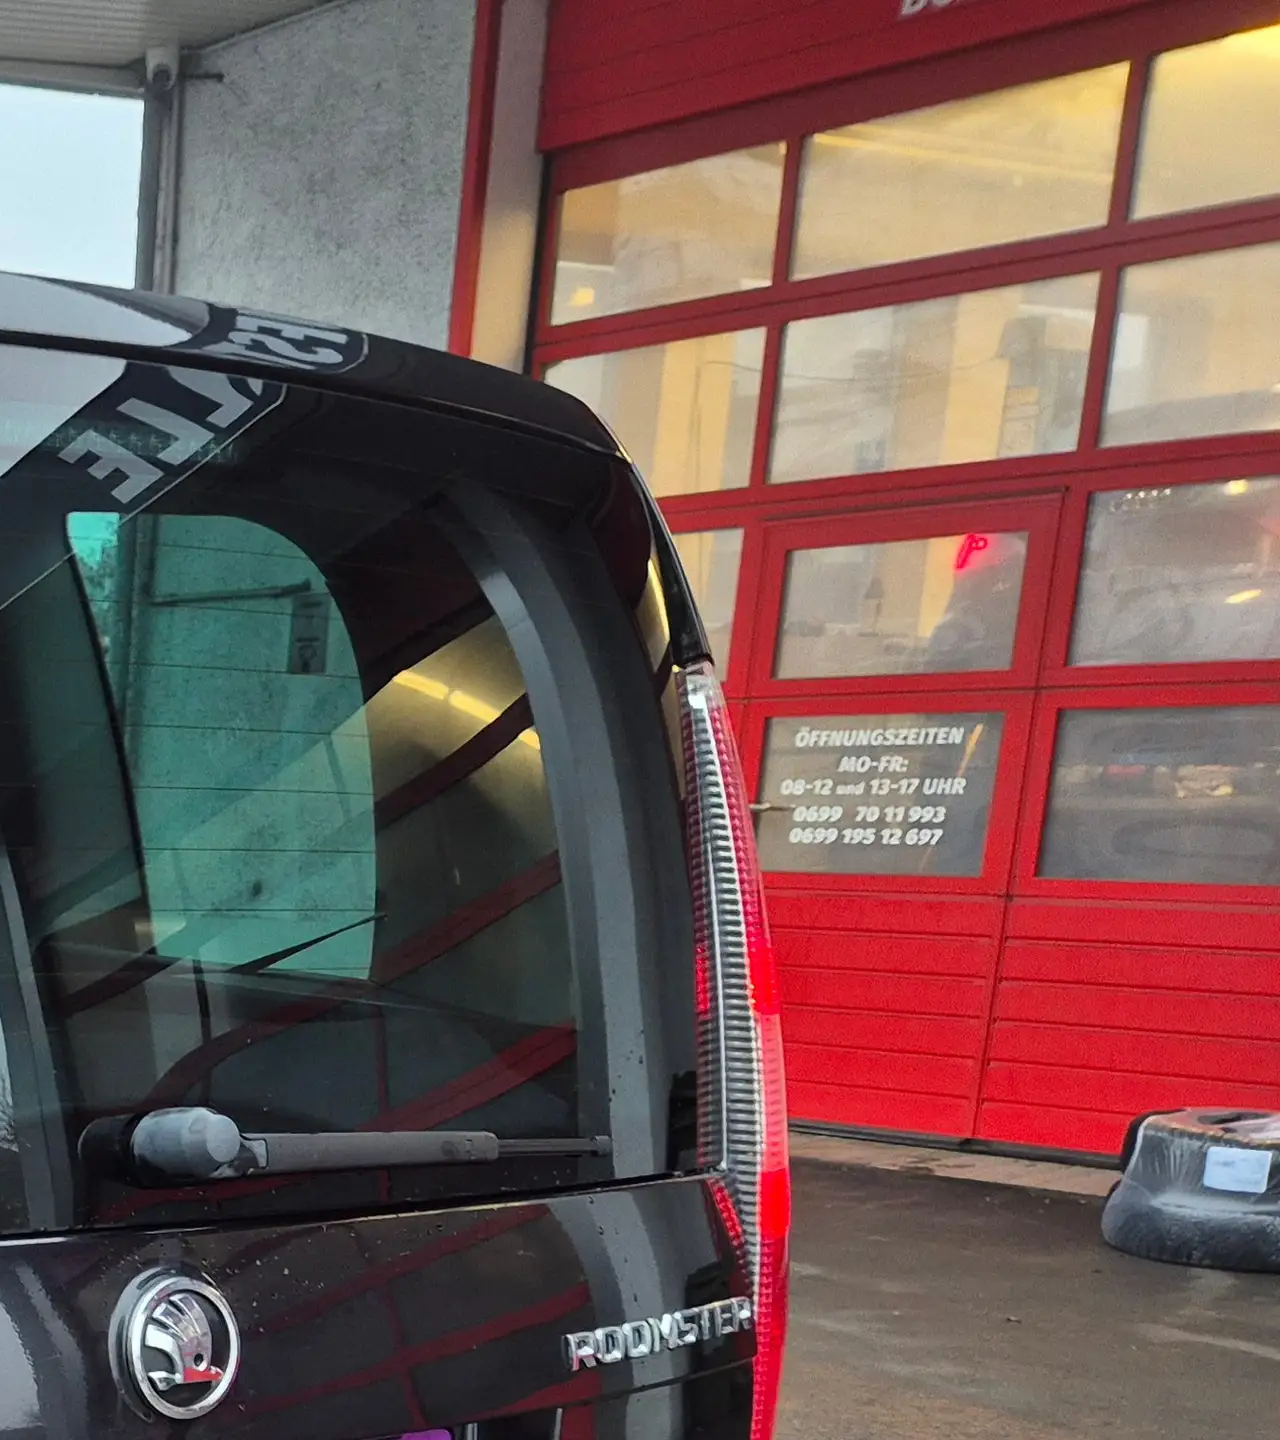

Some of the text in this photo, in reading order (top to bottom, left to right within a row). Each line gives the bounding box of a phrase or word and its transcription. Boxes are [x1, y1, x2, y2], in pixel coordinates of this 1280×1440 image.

[795, 726, 964, 747] ÖFFNUNGSZEITEN
[838, 756, 909, 773] MO-FR:
[780, 776, 967, 796] 08-12 und 13-17 UHR
[793, 806, 946, 823] 0699 70 11 993
[789, 828, 943, 845] 0699 195 12 697
